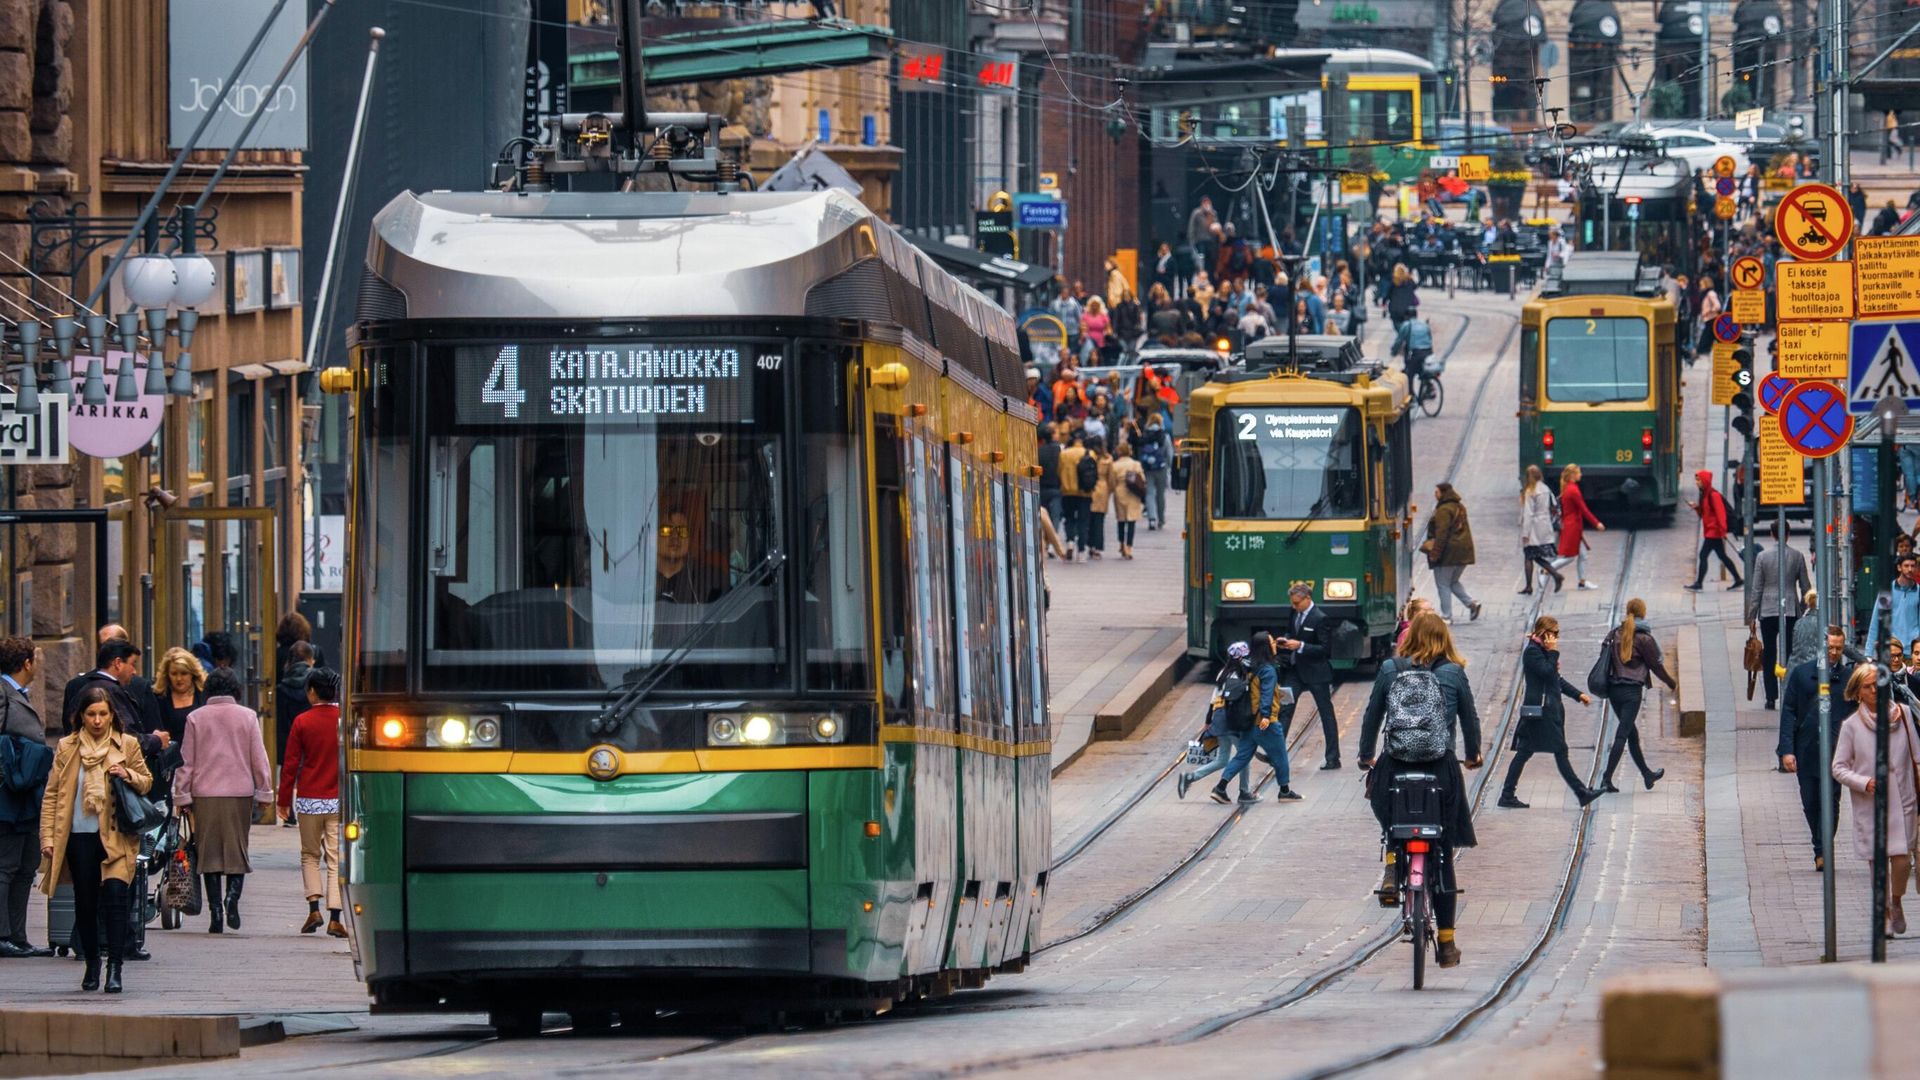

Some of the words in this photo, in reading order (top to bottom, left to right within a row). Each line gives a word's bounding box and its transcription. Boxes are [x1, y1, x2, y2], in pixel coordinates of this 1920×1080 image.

[556, 82, 566, 113] OTEL
[1859, 261, 1888, 271] sallittu
[1787, 268, 1796, 278] Ei
[1787, 280, 1826, 291] -takseja
[1862, 280, 1903, 292] purkaville
[1788, 292, 1841, 303] -huoltoajoa
[1863, 291, 1912, 301] ajoneuvoille
[1788, 305, 1844, 315] -tontilleajoa
[1584, 319, 1598, 335] 2
[1780, 327, 1807, 337] Gäller
[1811, 328, 1821, 338] ej
[1780, 339, 1802, 350] -taxi
[1780, 351, 1847, 361] -servicekörnin
[756, 355, 782, 370] 407
[481, 346, 526, 418] 4
[551, 349, 739, 379] KATAJANOKKA
[1738, 371, 1752, 386] S
[551, 385, 705, 414] SKATUDDEN
[68, 404, 149, 419] ARIKKA
[0, 416, 28, 443] rd
[1238, 413, 1257, 440] 2
[1264, 414, 1339, 426] Olympiaterminaali
[1269, 428, 1284, 438] via
[1285, 428, 1332, 439] Kauppatori
[1615, 449, 1633, 462] 89
